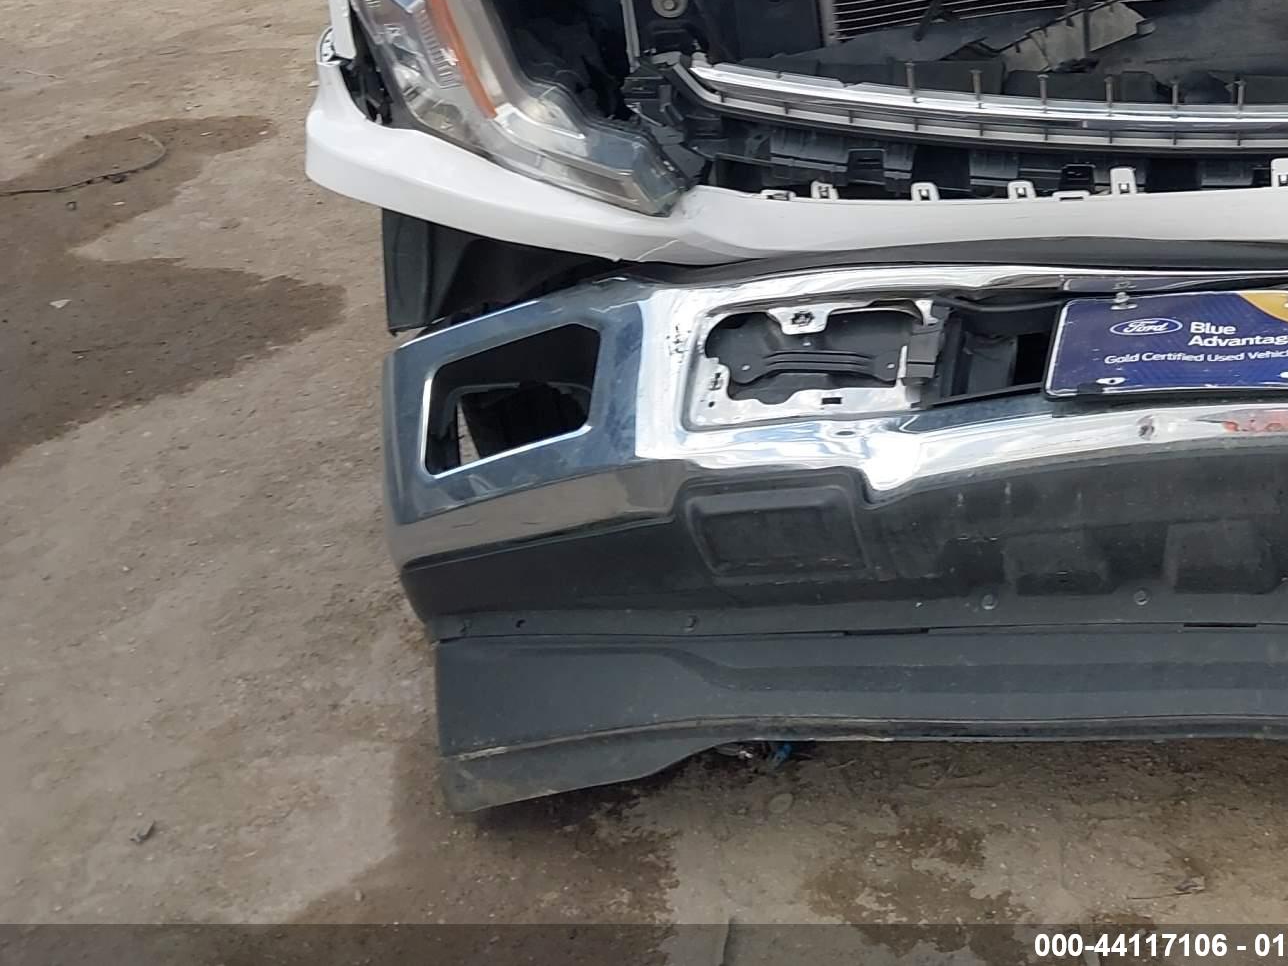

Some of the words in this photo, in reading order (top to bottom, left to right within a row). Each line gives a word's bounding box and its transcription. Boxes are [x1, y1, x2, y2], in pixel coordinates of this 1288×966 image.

[1122, 320, 1168, 333] Ford
[1190, 321, 1236, 334] Blue
[1104, 353, 1140, 364] Gold
[1141, 352, 1204, 362] Certified
[1206, 352, 1245, 362] Used
